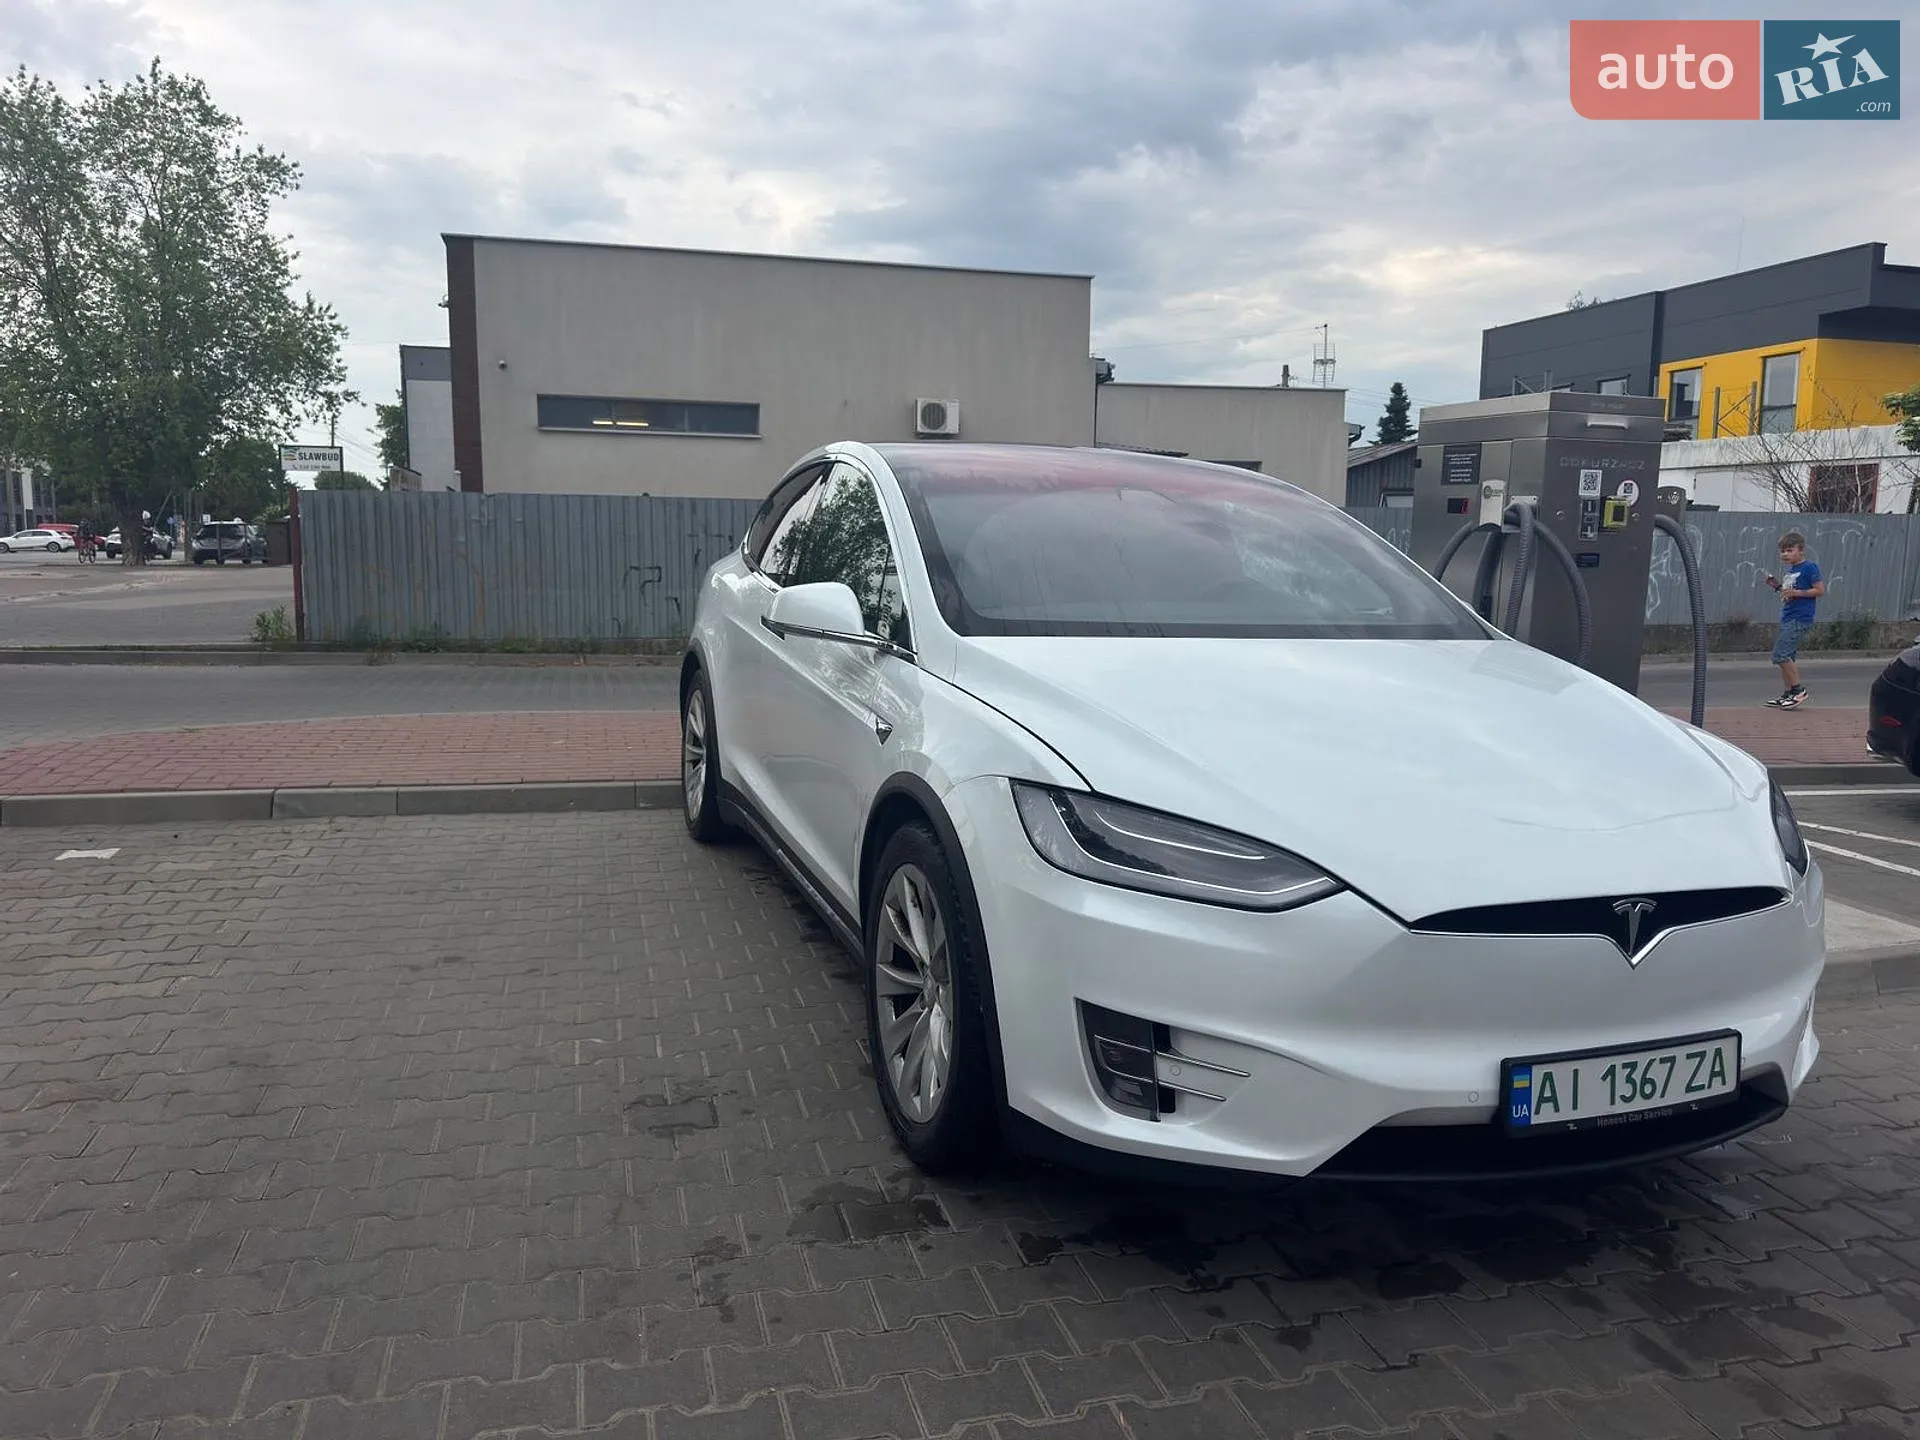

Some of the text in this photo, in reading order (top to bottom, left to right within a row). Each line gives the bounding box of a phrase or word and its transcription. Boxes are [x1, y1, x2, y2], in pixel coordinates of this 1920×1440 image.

[1534, 1046, 1727, 1116] AI 1367 ZA
[1512, 1104, 1530, 1119] UA
